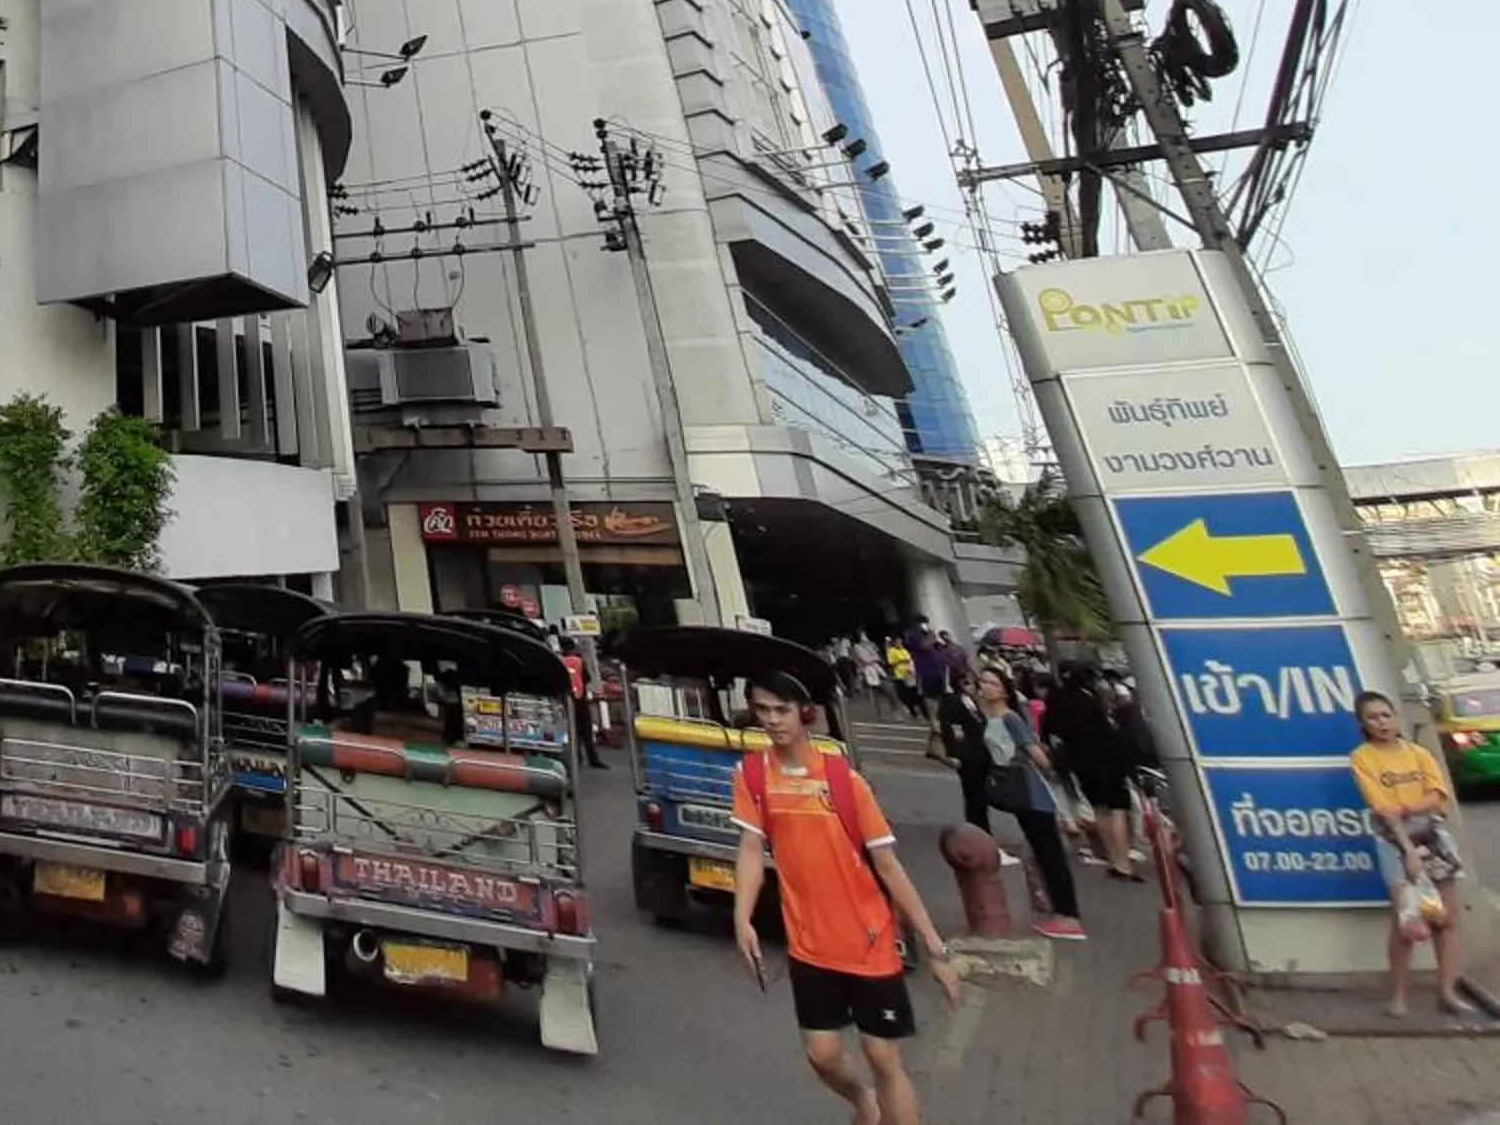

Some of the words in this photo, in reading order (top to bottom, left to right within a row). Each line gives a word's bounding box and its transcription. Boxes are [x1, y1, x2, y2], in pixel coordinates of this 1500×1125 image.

[1107, 394, 1228, 427] พันธุ์ทิพย์
[1104, 445, 1274, 473] งามวงศ์วาน
[1243, 851, 1373, 872] 07.00-22.00
[353, 857, 518, 903] THAILAND
